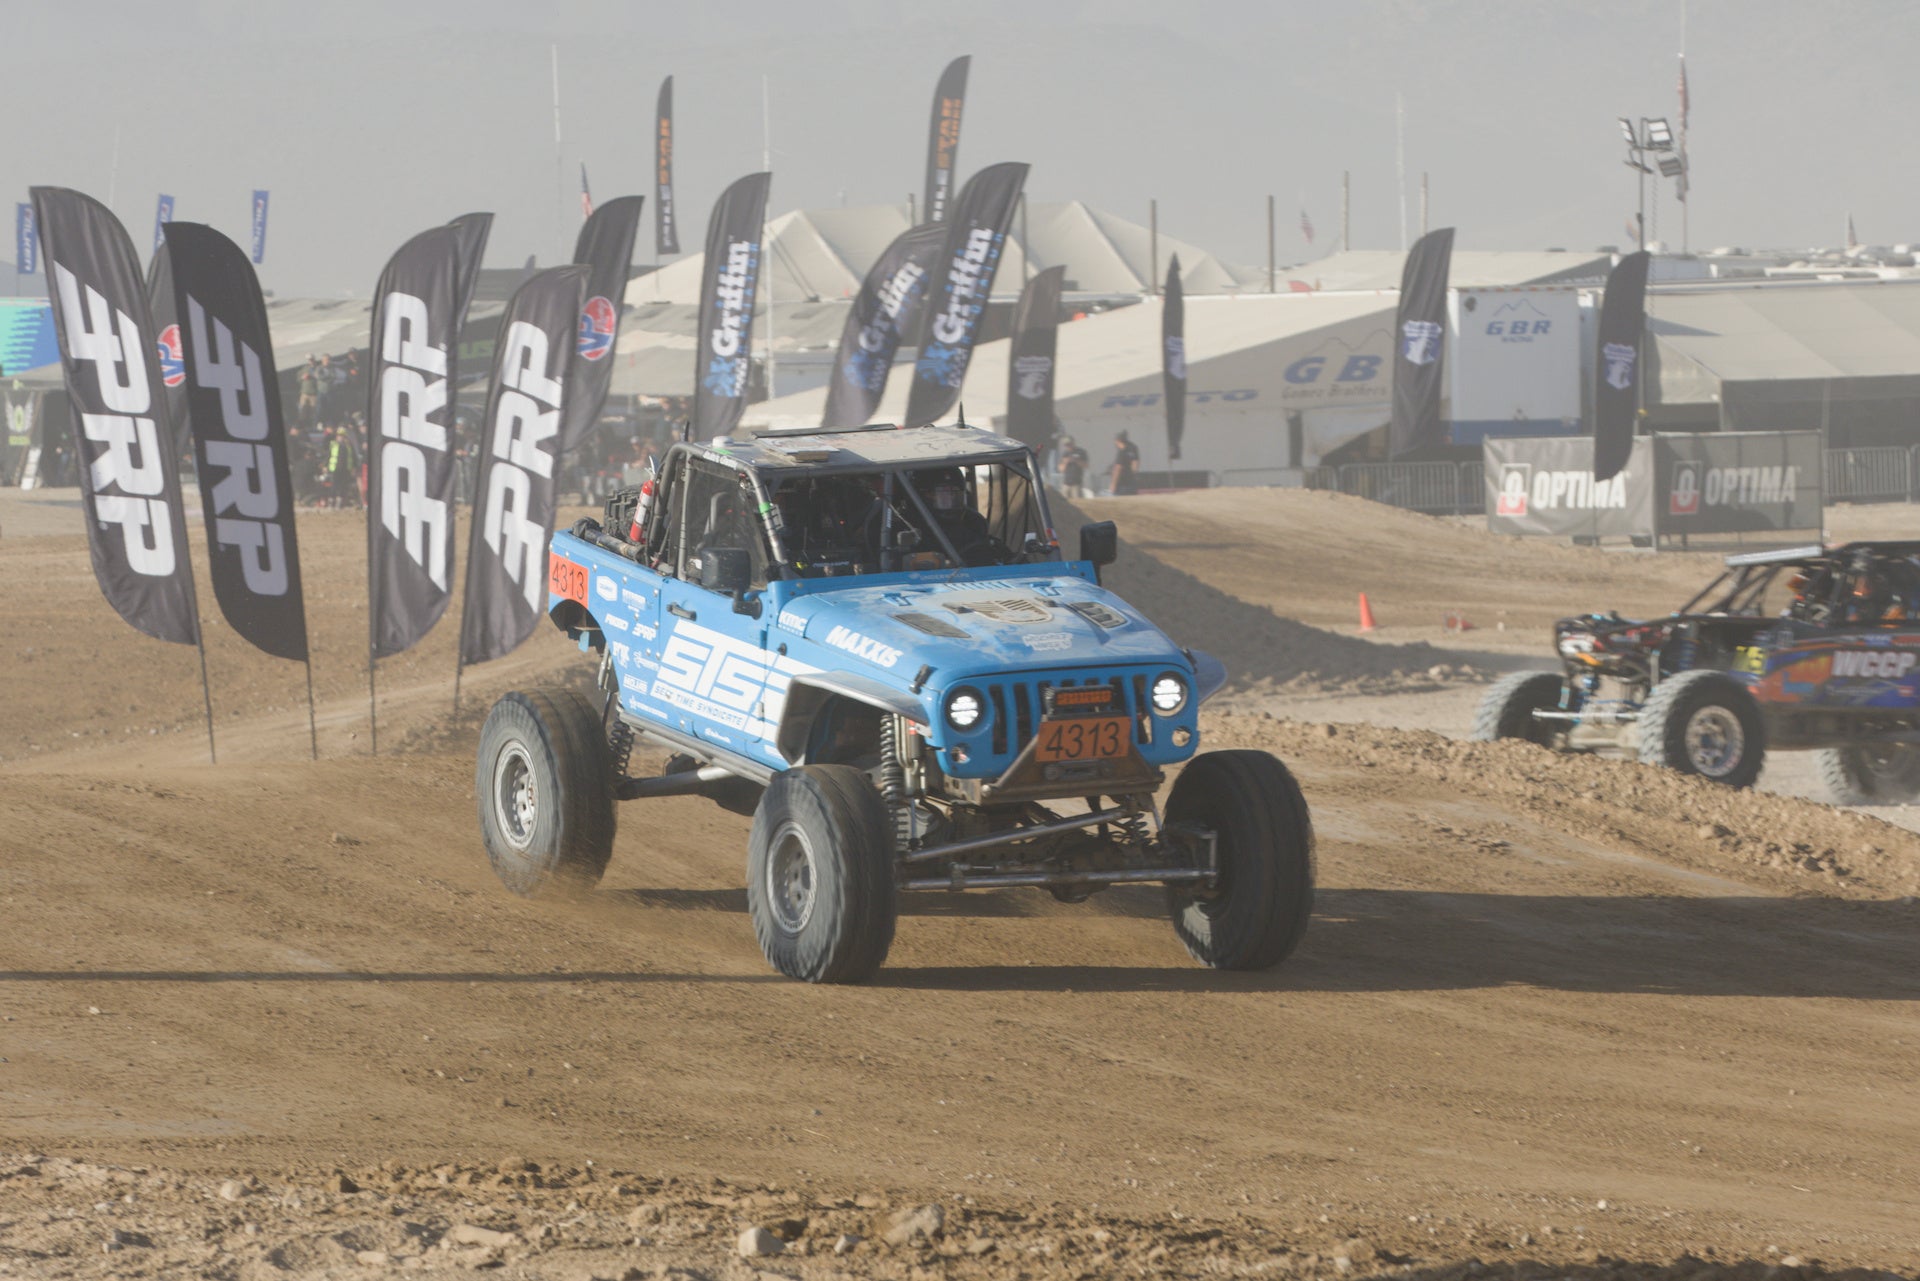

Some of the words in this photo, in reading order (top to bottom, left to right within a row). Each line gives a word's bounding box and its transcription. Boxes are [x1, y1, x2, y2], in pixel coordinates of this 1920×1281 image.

[711, 240, 751, 357] Griffin
[932, 228, 994, 344] Griffin
[858, 261, 926, 353] Griffin
[1486, 320, 1552, 335] GBR
[1532, 470, 1627, 509] OPTIMA
[1704, 465, 1796, 505] OPTIMA
[552, 561, 585, 600] 4313
[825, 625, 904, 668] MAXXIS
[1831, 650, 1916, 678] WCCP
[1045, 721, 1119, 758] 4313
